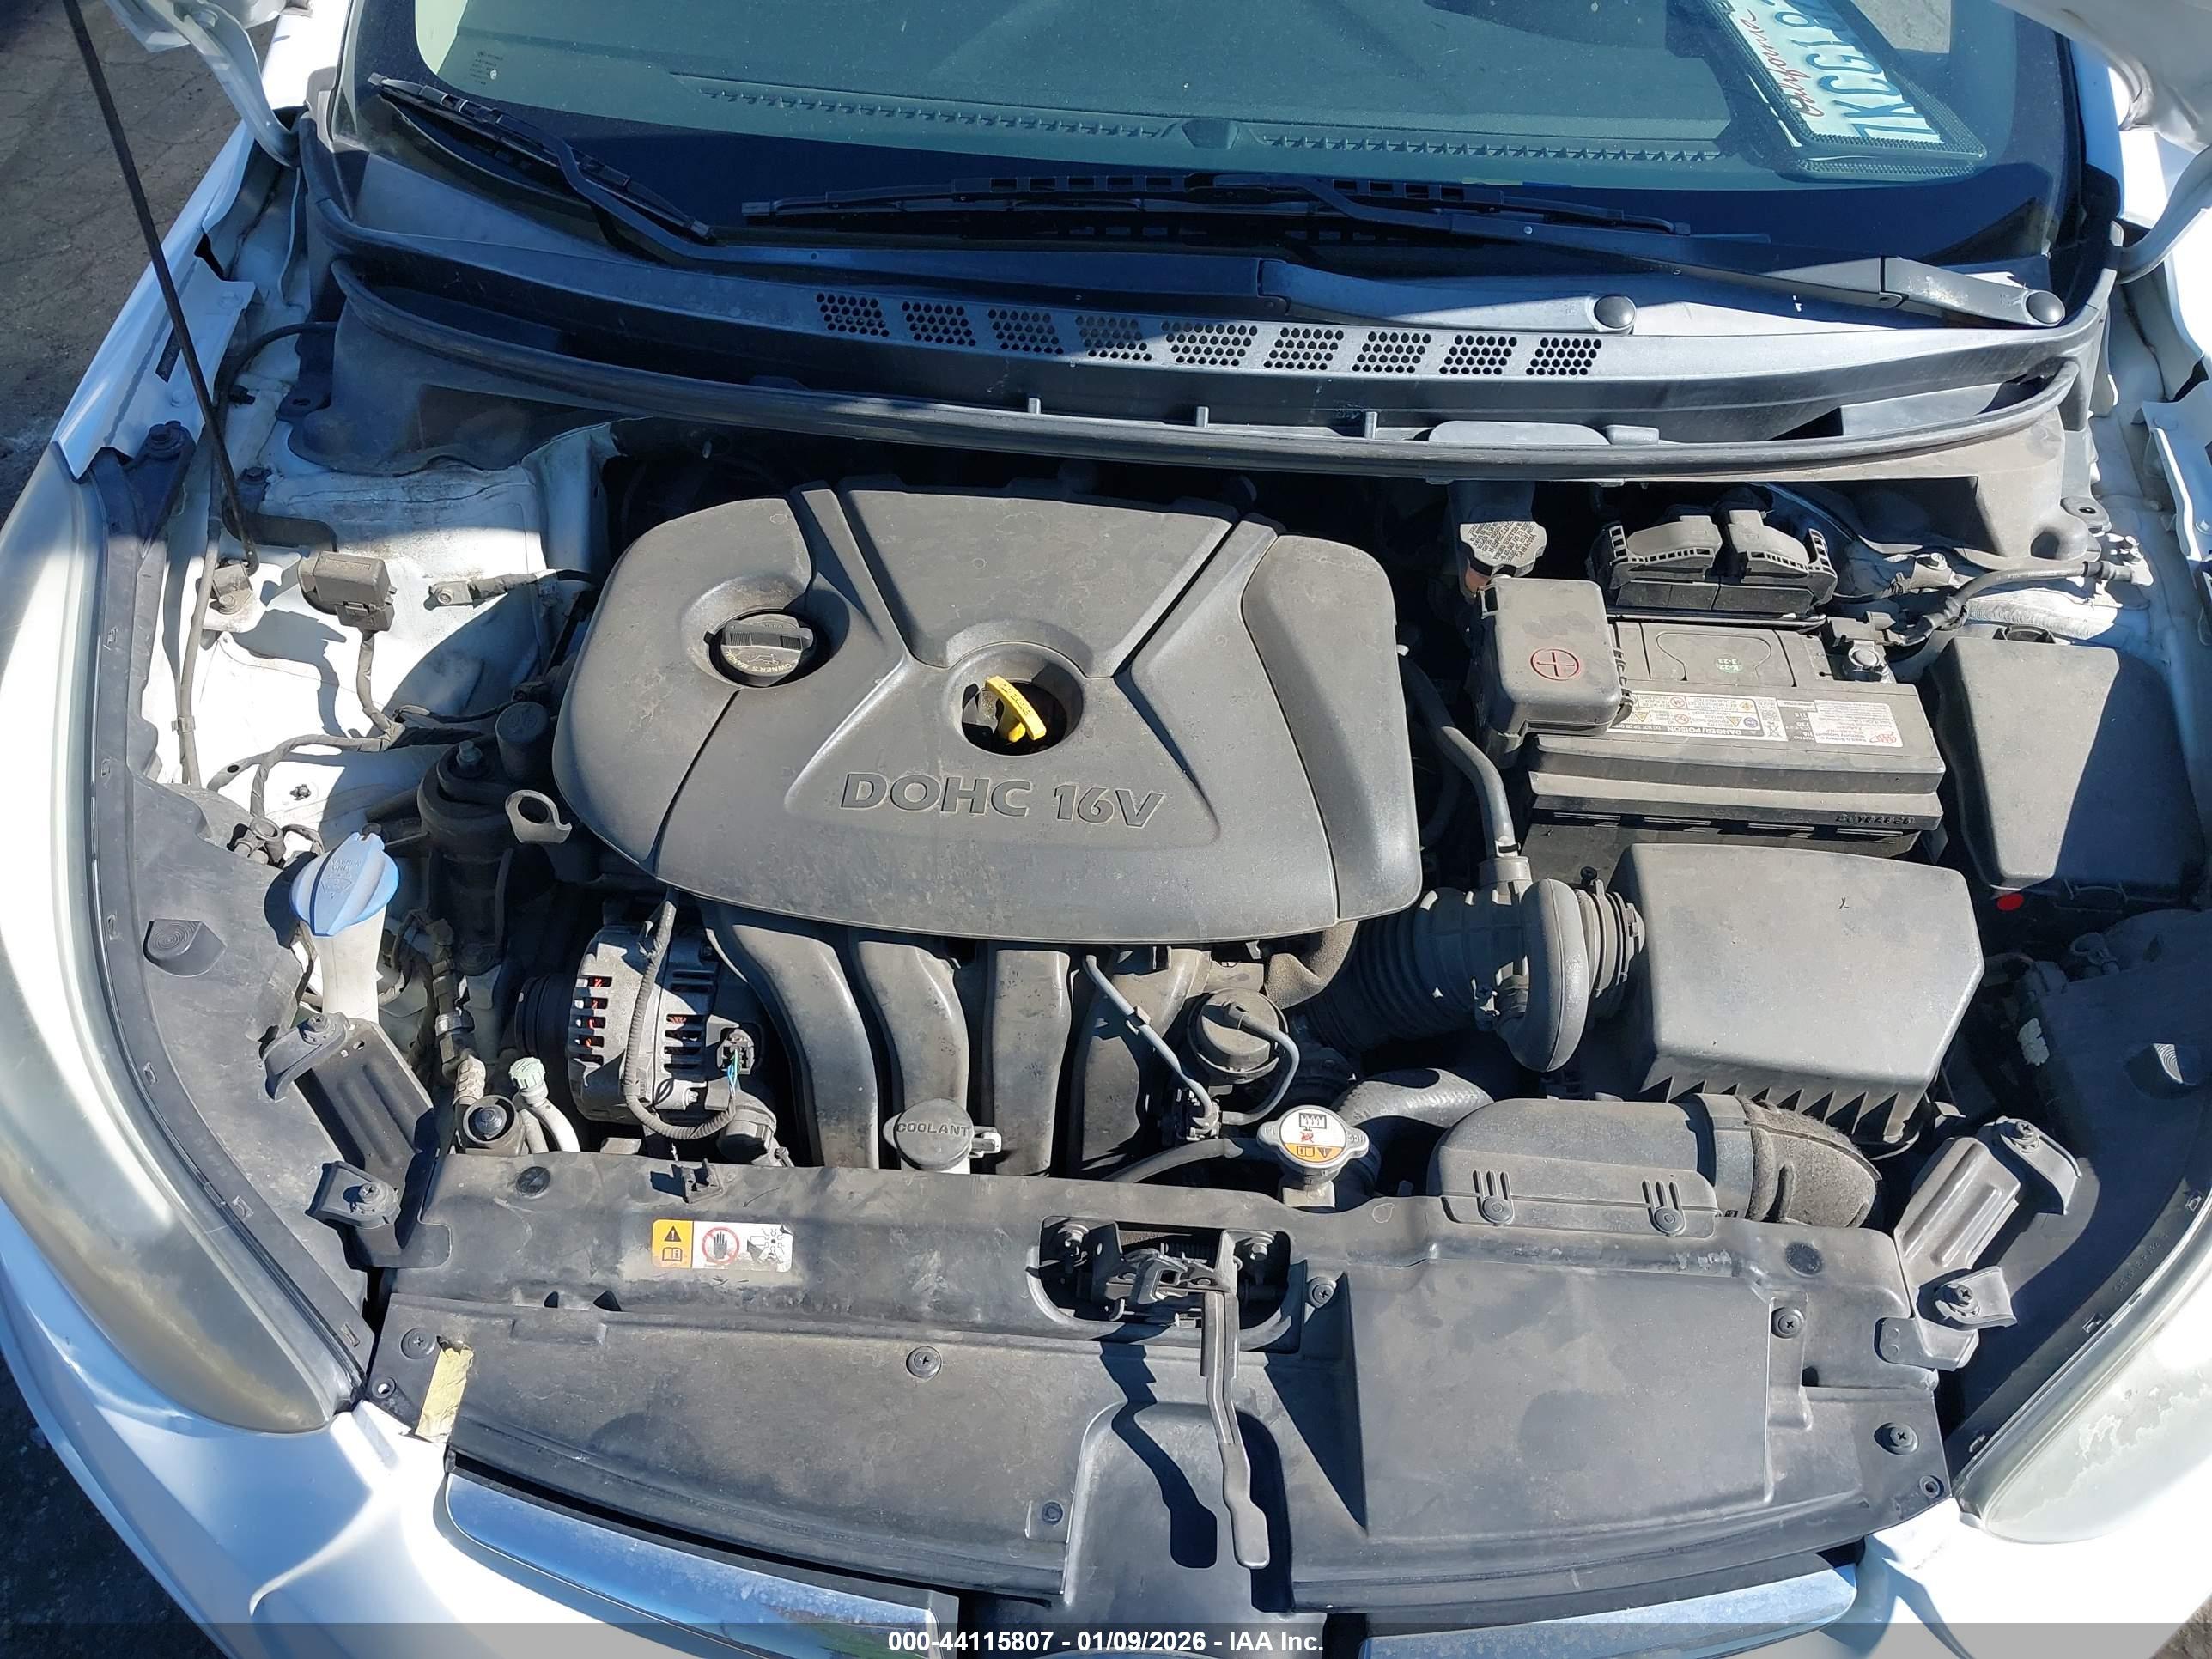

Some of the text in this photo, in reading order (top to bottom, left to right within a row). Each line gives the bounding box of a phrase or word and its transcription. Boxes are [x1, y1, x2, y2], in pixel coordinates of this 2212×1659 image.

[1740, 8, 1824, 118] California
[1760, 0, 1941, 143] 7KCG18
[724, 649, 793, 674] OWNER'S MANUAL
[1667, 726, 1742, 736] DANGER/POISON
[840, 771, 1165, 829] DOHC 16V
[896, 1122, 971, 1138] COOLANT
